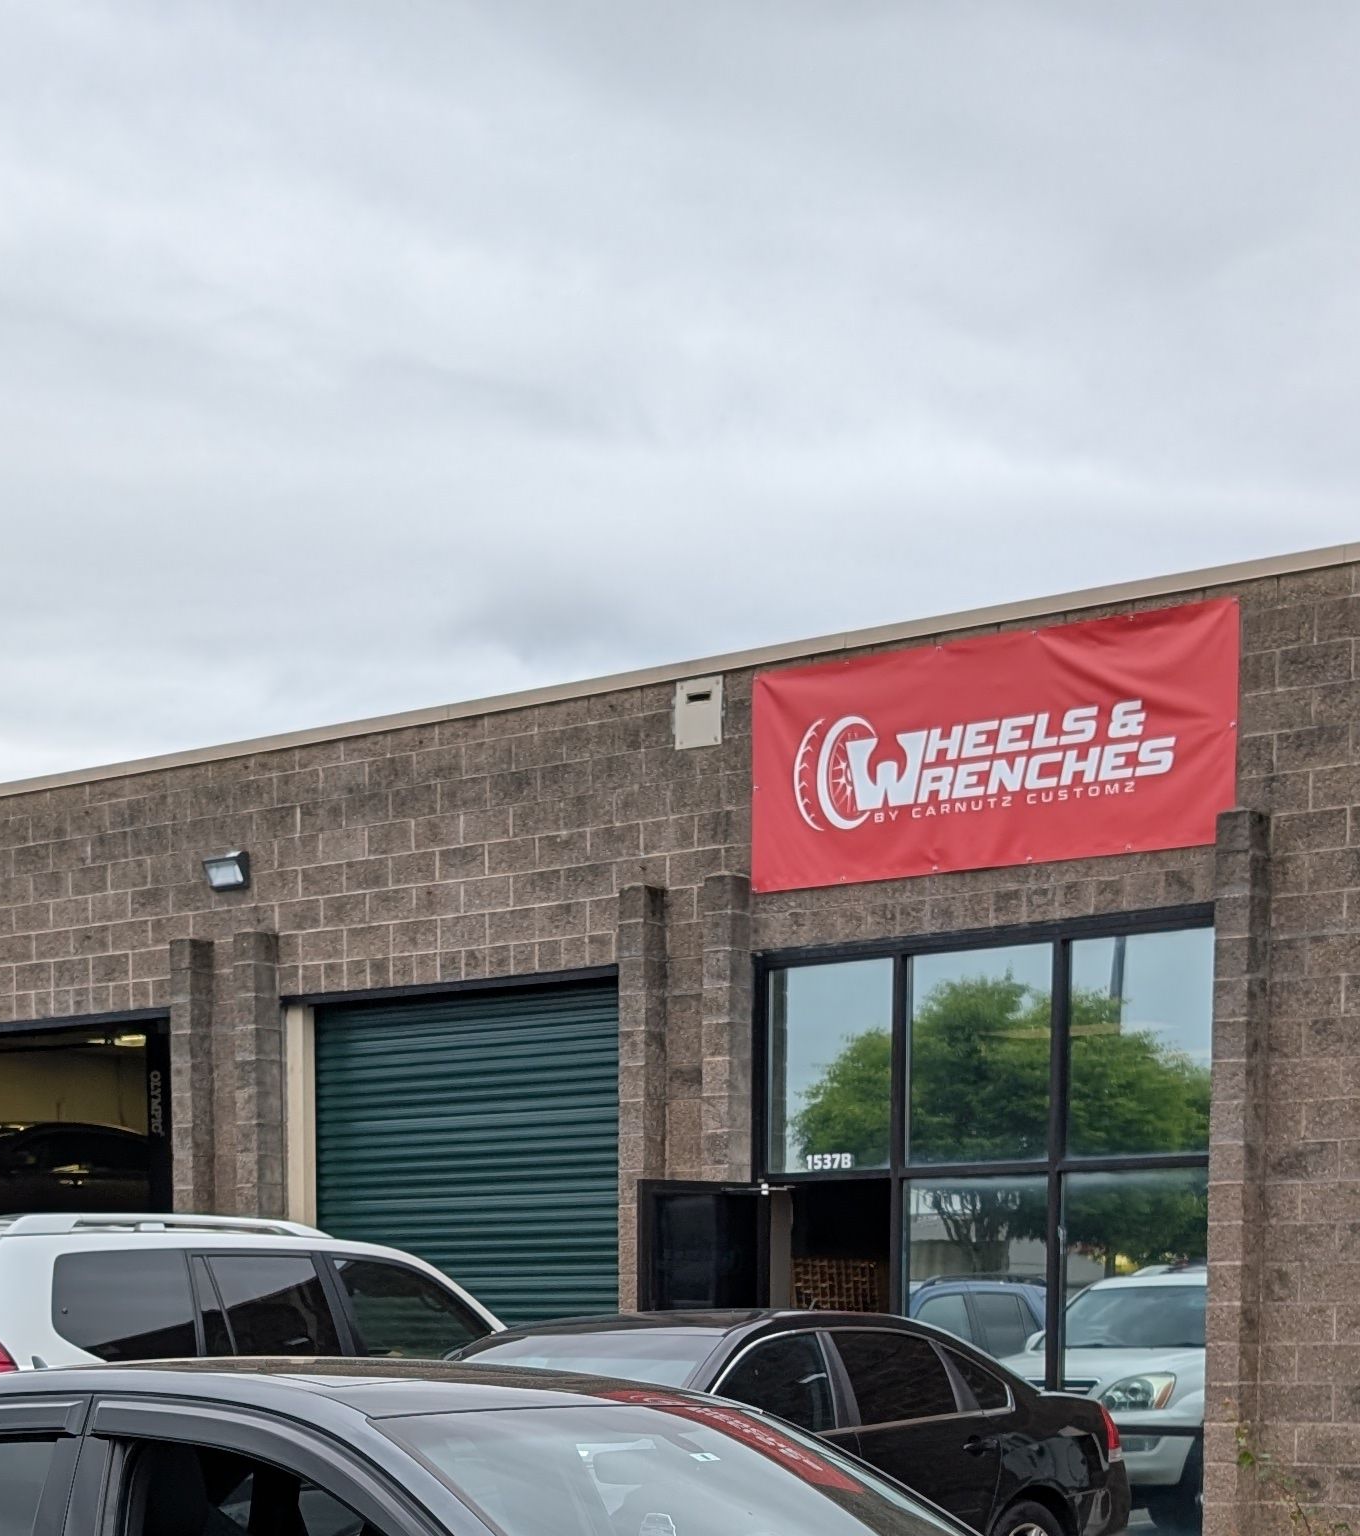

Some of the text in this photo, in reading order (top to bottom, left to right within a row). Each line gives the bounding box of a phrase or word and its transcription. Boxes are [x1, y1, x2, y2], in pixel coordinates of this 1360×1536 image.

[846, 699, 1146, 808] WHEELS &
[846, 731, 1176, 811] WRENCHES
[874, 781, 1137, 824] BY CARNUTZ CUSTOMZ
[150, 1070, 163, 1133] OLYMPIC
[806, 1152, 852, 1170] 1537B
